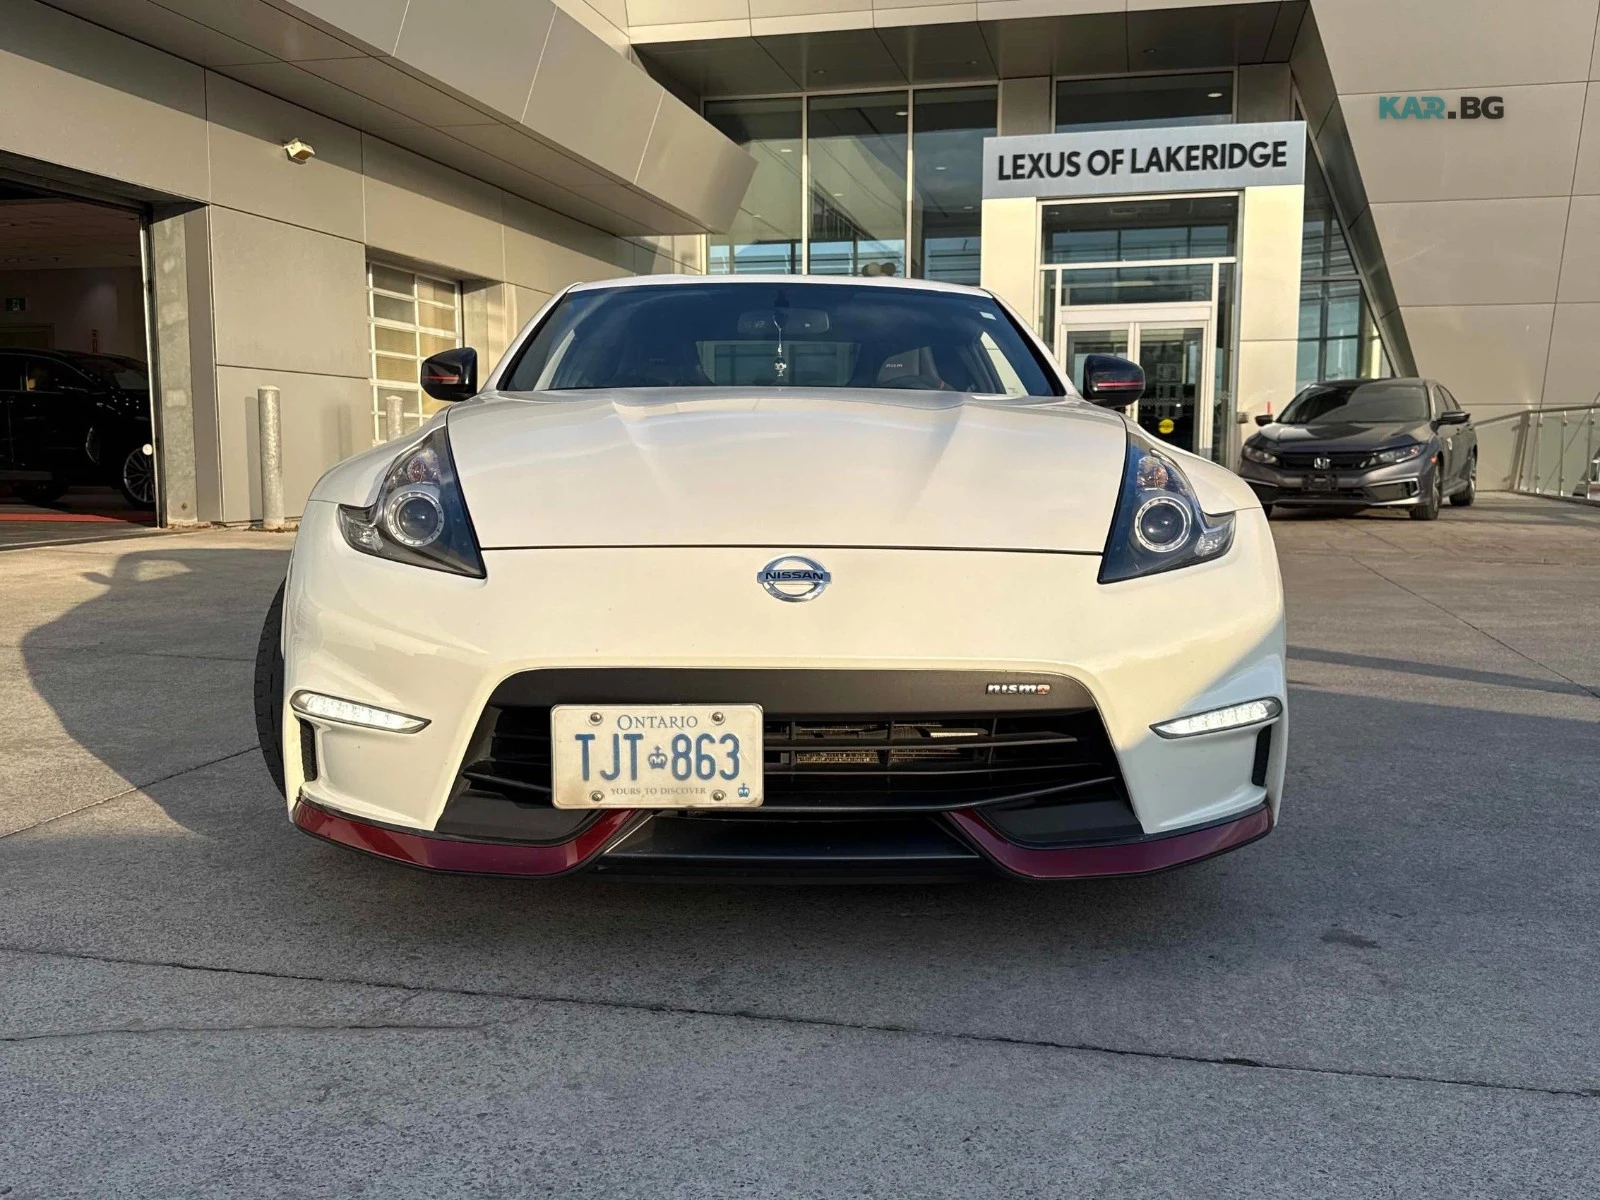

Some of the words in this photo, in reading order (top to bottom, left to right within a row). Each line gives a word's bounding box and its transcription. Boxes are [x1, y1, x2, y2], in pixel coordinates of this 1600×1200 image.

[998, 150, 1081, 181] LEXUS
[1087, 148, 1124, 176] OF
[1130, 140, 1288, 174] LAKERIDGE
[765, 571, 823, 580] NISSAN
[575, 733, 644, 781] TJT
[671, 733, 740, 780] 863
[610, 787, 641, 796] YOURS
[644, 787, 657, 796] TO
[660, 786, 707, 796] DISCOVER
